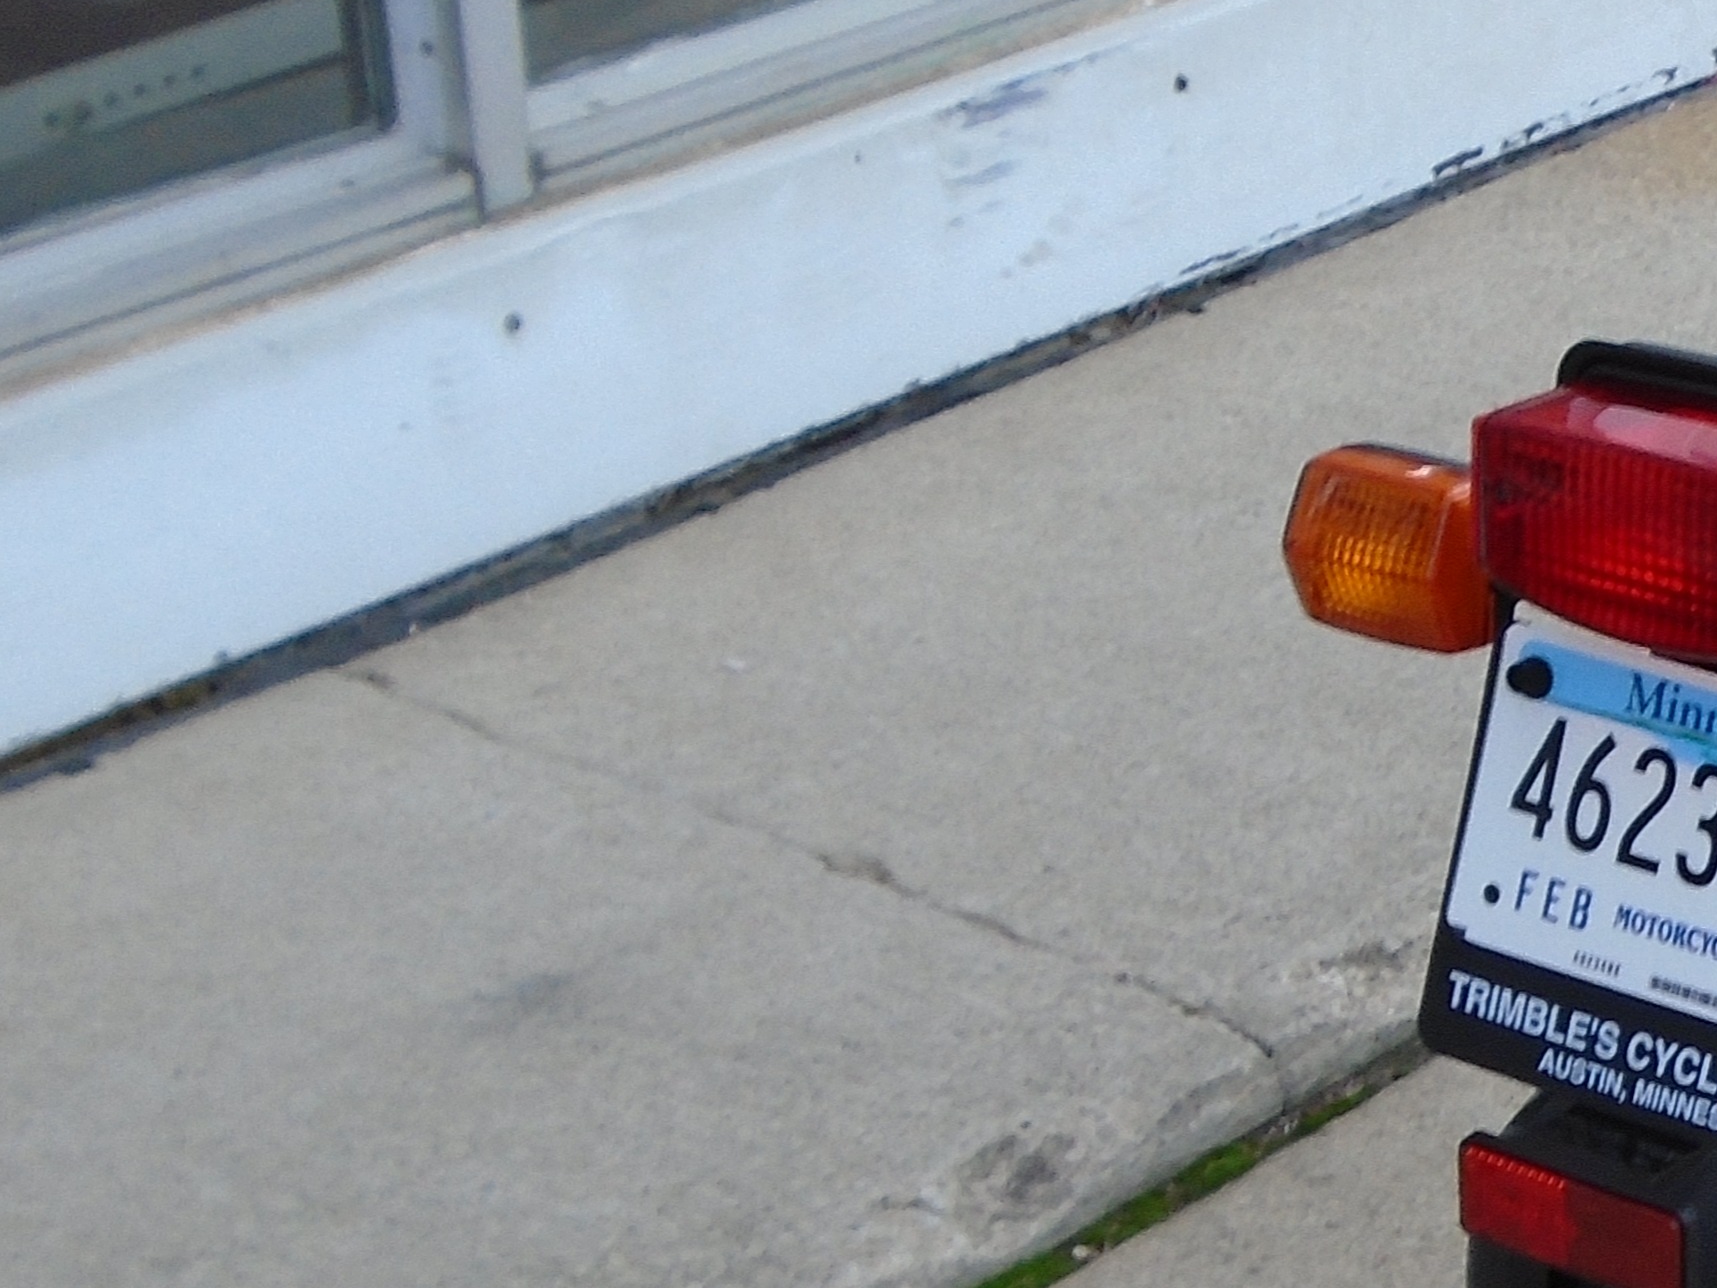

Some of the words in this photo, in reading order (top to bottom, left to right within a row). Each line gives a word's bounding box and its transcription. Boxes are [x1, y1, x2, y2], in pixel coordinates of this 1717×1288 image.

[1514, 869, 1593, 931] FEB
[1448, 969, 1619, 1062] TRIMBLE'S
[1536, 1047, 1628, 1106] AUSTIN,
